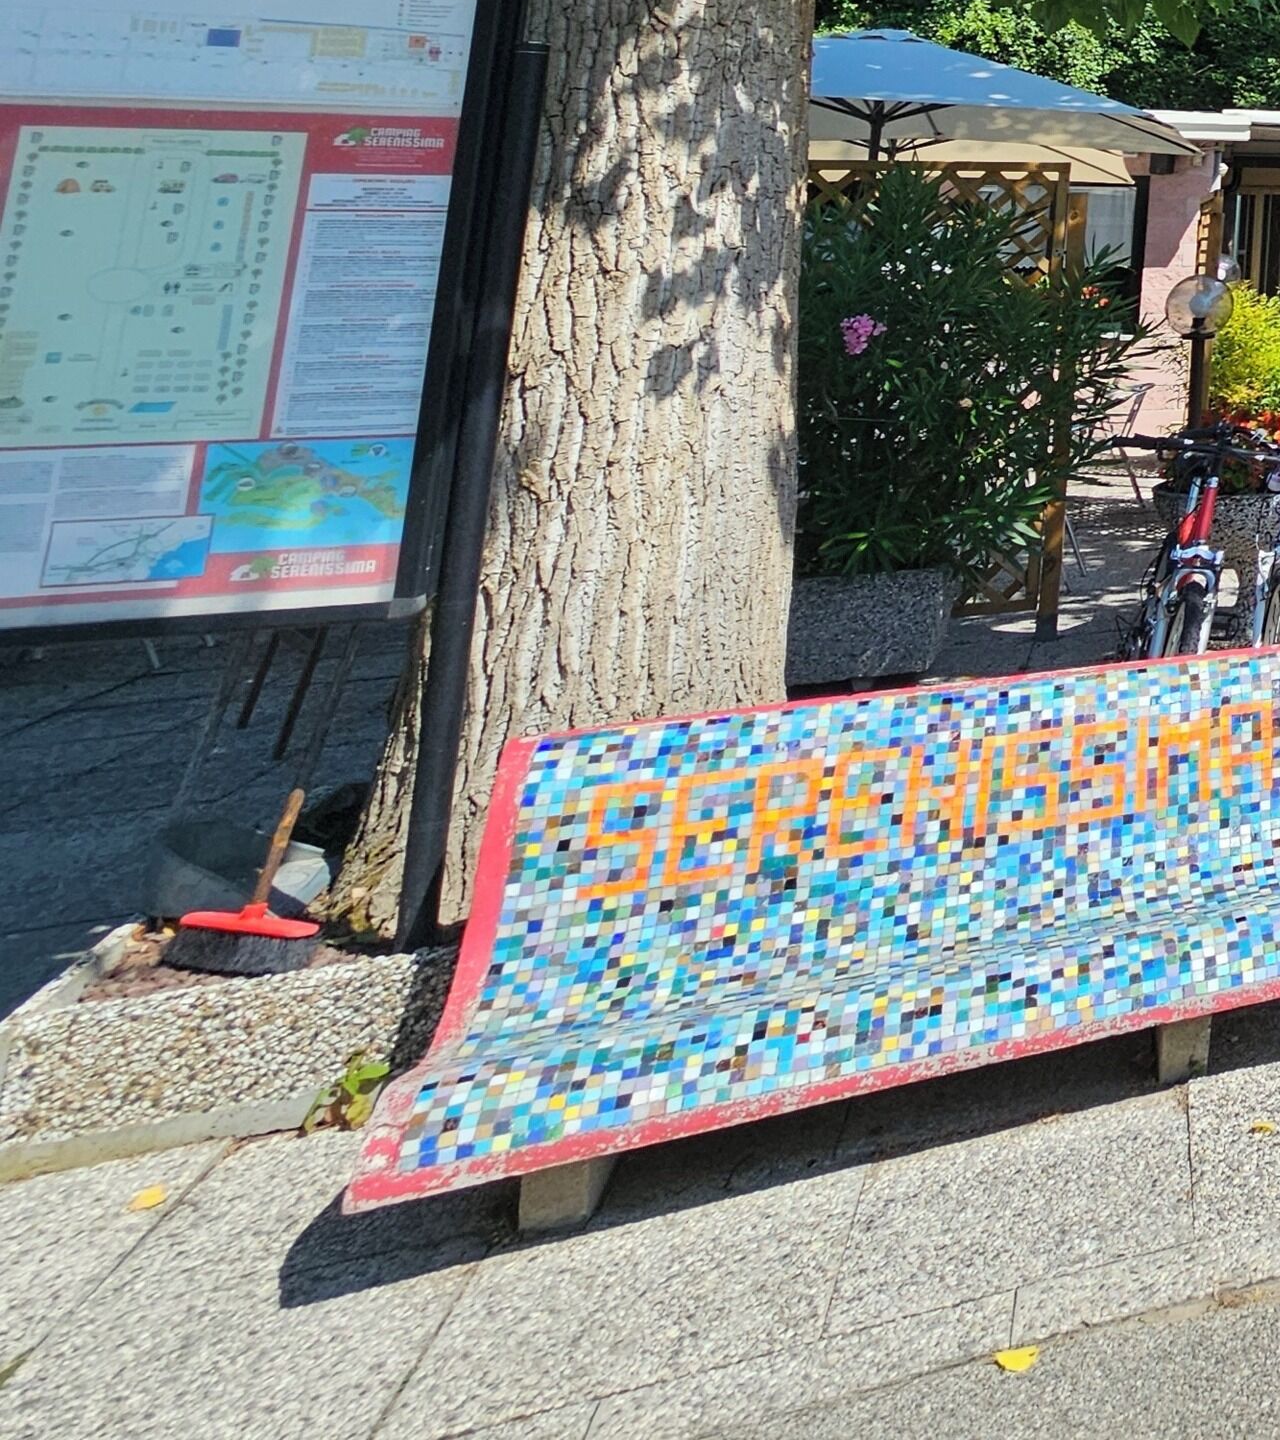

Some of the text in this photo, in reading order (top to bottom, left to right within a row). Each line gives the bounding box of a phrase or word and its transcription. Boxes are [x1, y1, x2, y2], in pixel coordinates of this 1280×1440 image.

[370, 127, 421, 138] CAMPING
[363, 136, 445, 148] SERENISSIMA
[278, 550, 345, 566] CAMPING
[270, 560, 376, 579] SERENISSIMA
[577, 700, 1273, 898] SERENISSIMA
